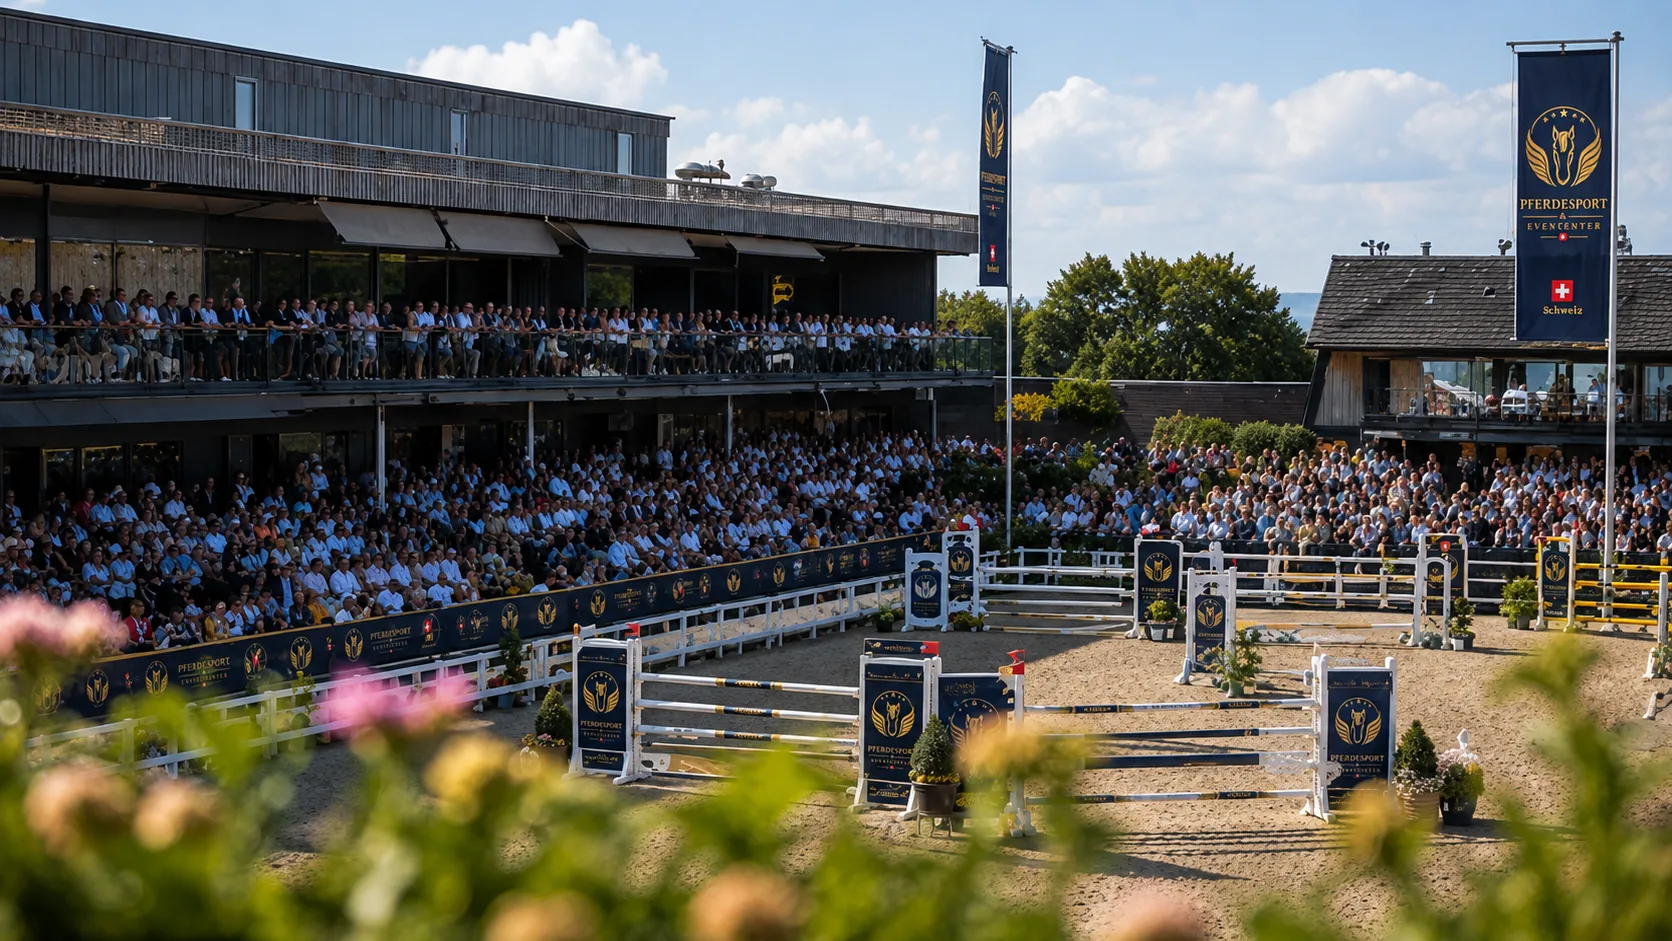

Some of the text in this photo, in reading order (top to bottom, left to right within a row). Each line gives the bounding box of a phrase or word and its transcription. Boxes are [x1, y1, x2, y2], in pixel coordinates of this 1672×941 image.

[1520, 198, 1608, 210] PFERDESPORT
[1527, 222, 1601, 231] EVENCENTER
[1543, 304, 1583, 315] Schweiz
